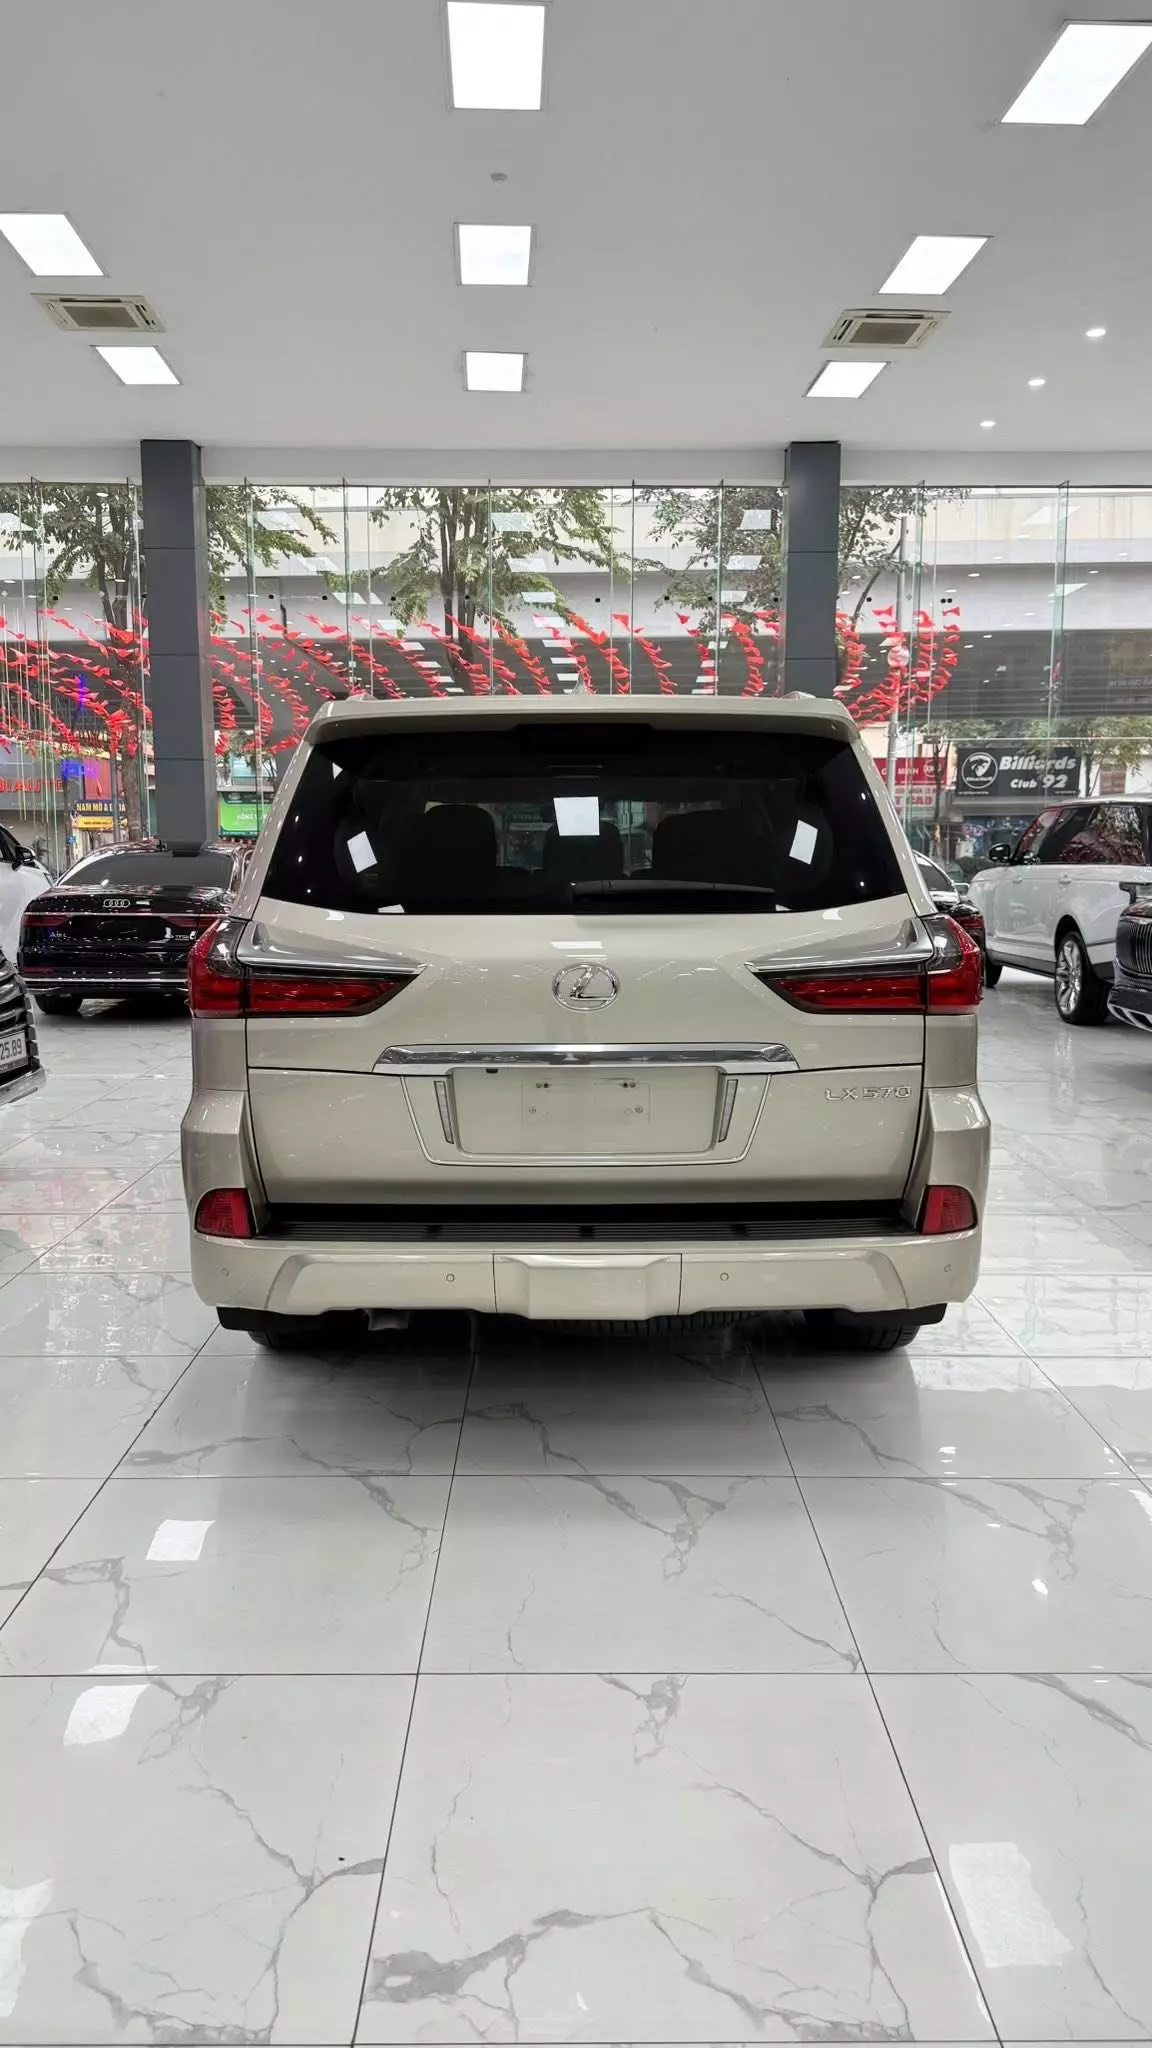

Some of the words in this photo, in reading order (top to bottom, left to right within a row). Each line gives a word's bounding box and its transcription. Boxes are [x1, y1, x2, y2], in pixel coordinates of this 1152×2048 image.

[999, 755, 1077, 771] Billiards
[1010, 778, 1037, 789] Club
[1042, 774, 1068, 789] 92
[76, 802, 92, 812] NAM
[825, 1087, 858, 1101] LX
[862, 1084, 912, 1100] 570
